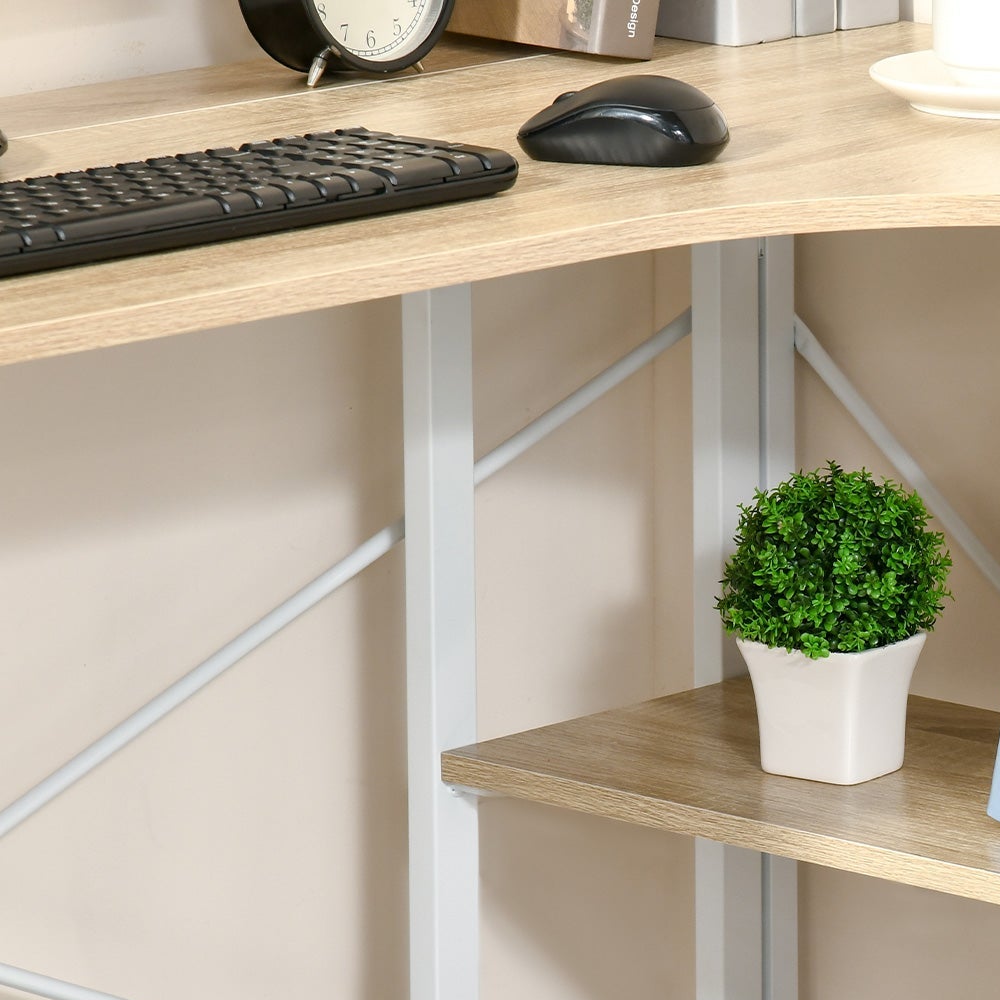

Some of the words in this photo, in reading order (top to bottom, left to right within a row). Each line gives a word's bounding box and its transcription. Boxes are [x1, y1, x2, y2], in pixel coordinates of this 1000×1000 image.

[340, 23, 349, 42] 7
[392, 18, 402, 37] 5
[366, 30, 376, 48] 6
